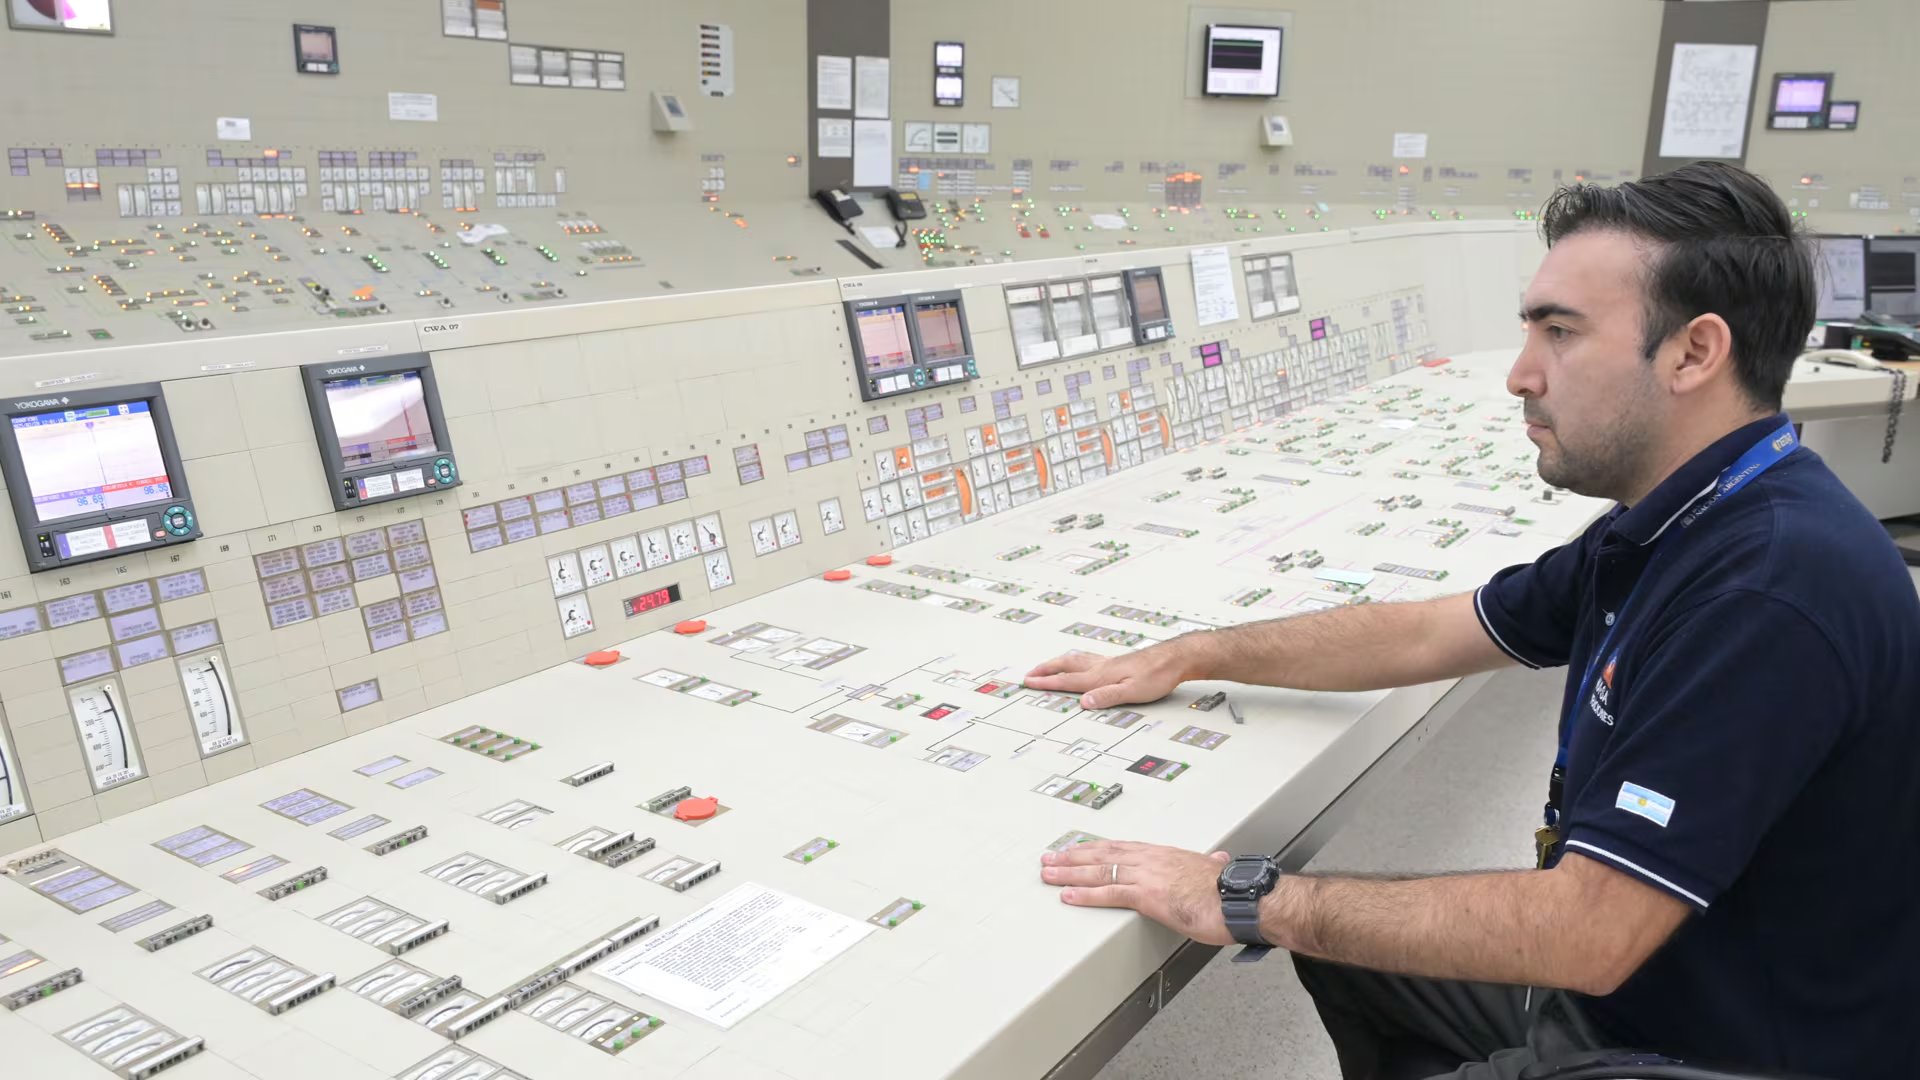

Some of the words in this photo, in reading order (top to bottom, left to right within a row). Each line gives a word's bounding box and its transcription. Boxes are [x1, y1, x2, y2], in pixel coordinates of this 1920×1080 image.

[326, 366, 359, 375] YOKOGAWA
[14, 398, 60, 409] YOKOGAWA
[1722, 463, 1760, 494] ARGENTINA
[76, 494, 104, 506] 96.69
[267, 534, 277, 542] 171
[220, 544, 230, 552] 169
[170, 554, 180, 563] 167
[116, 566, 127, 574] 165
[59, 578, 71, 586] 163
[0, 591, 12, 599] 161
